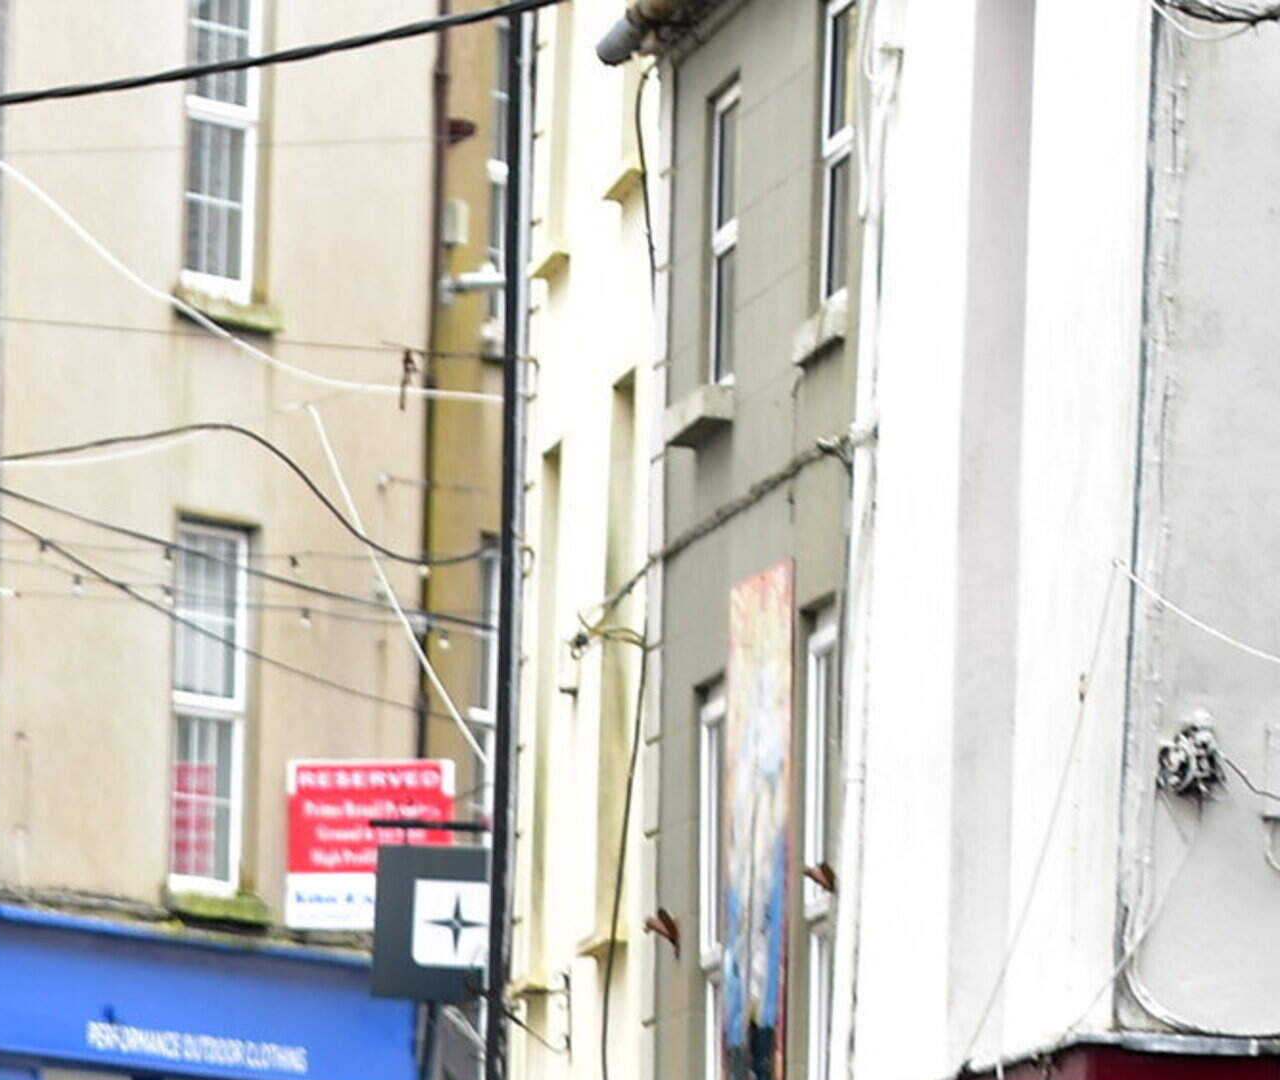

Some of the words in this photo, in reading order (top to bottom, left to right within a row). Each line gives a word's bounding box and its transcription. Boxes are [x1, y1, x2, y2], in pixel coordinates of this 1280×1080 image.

[298, 769, 441, 788] RESERVED
[86, 1020, 181, 1062] PERFORMANCE
[182, 1033, 242, 1068] OUTDOOR
[243, 1040, 308, 1075] CLOTHING
